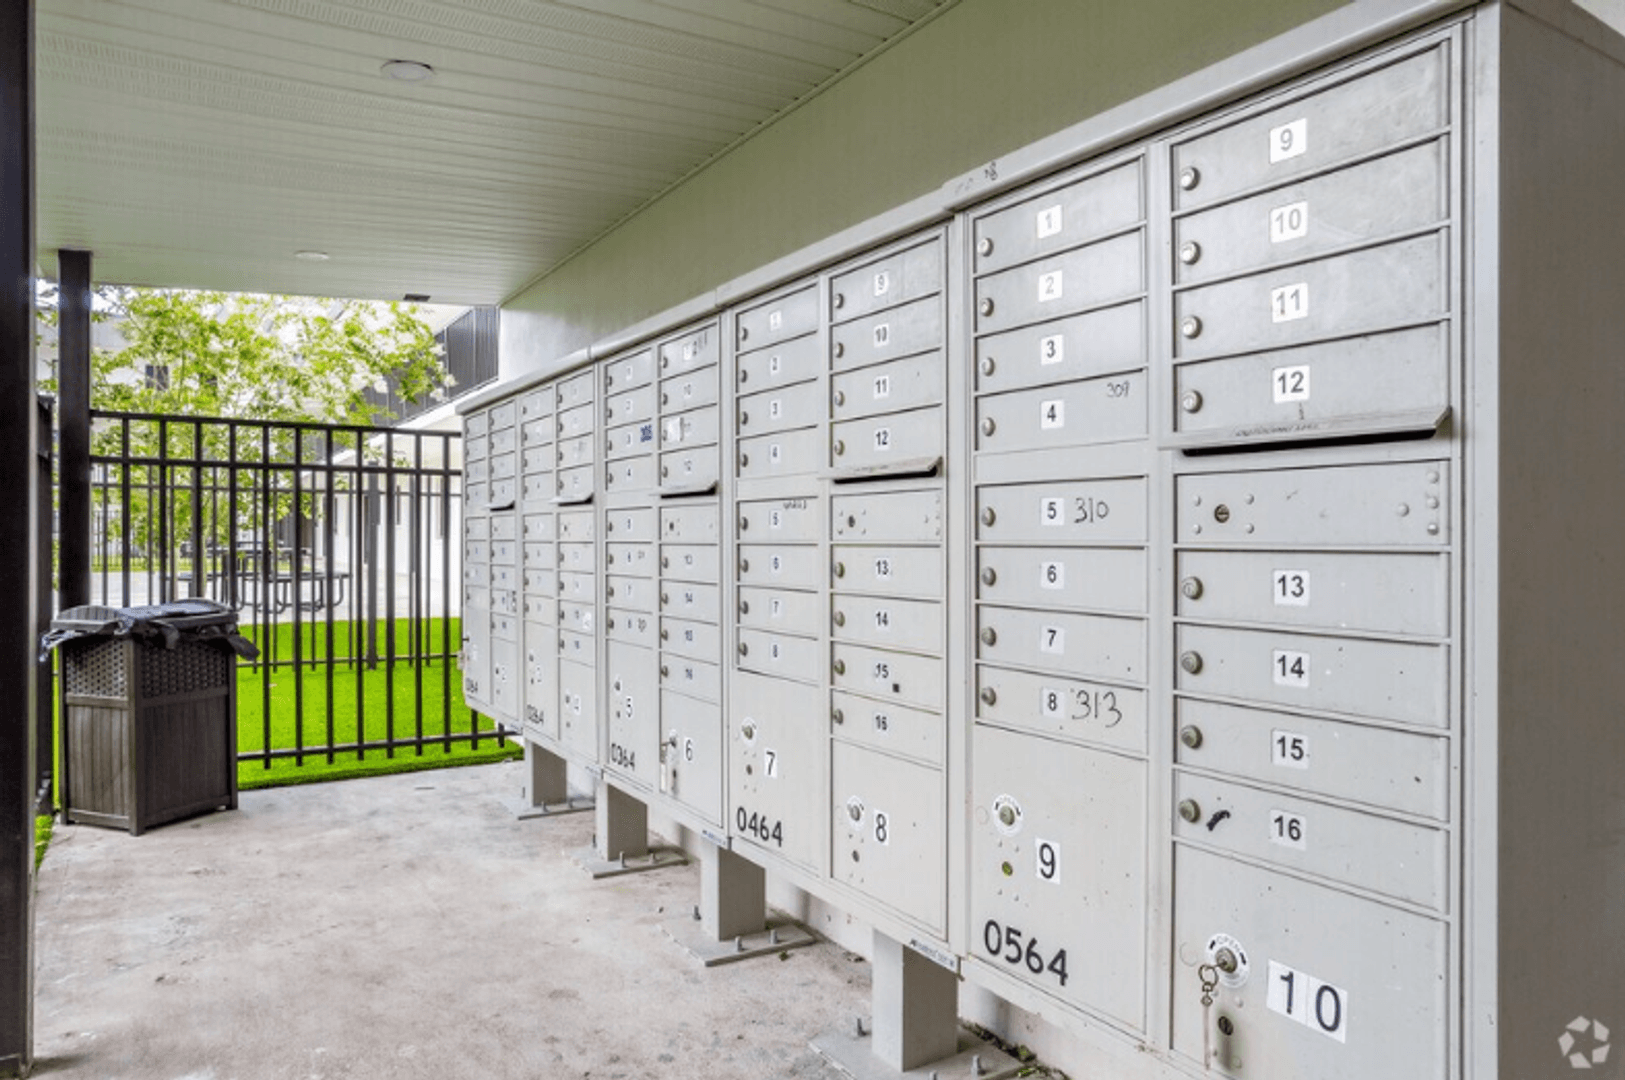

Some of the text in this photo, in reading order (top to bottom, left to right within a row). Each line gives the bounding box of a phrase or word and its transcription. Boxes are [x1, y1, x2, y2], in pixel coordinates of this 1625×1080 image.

[1280, 127, 1294, 152] 9
[1274, 207, 1302, 235] 10
[1045, 276, 1055, 295] 2
[1275, 288, 1301, 315] 11
[876, 326, 888, 343] 10
[1046, 339, 1056, 359] 3
[876, 378, 887, 394] 11
[1277, 370, 1306, 395] 12
[1046, 404, 1057, 423] 4
[876, 430, 889, 446] 12
[1047, 501, 1057, 520] 5
[1074, 497, 1110, 524] 310
[876, 559, 889, 576] 13
[1047, 564, 1057, 584] 6
[1277, 573, 1305, 598] 13
[875, 611, 888, 627] 14
[1047, 628, 1057, 648] 7
[875, 663, 889, 680] 15
[1277, 654, 1305, 679] 14
[1047, 692, 1058, 712] 8
[1071, 689, 1123, 728] 313
[875, 714, 888, 731] 16
[610, 742, 635, 772] 0364
[685, 738, 693, 762] 6
[1276, 735, 1305, 761] 15
[765, 751, 776, 776] 7
[736, 806, 783, 848] 0464
[874, 813, 888, 843] 8
[1273, 815, 1303, 842] 16
[1039, 842, 1056, 880] 9
[984, 919, 1069, 987] 0564
[1280, 970, 1342, 1033] 10
